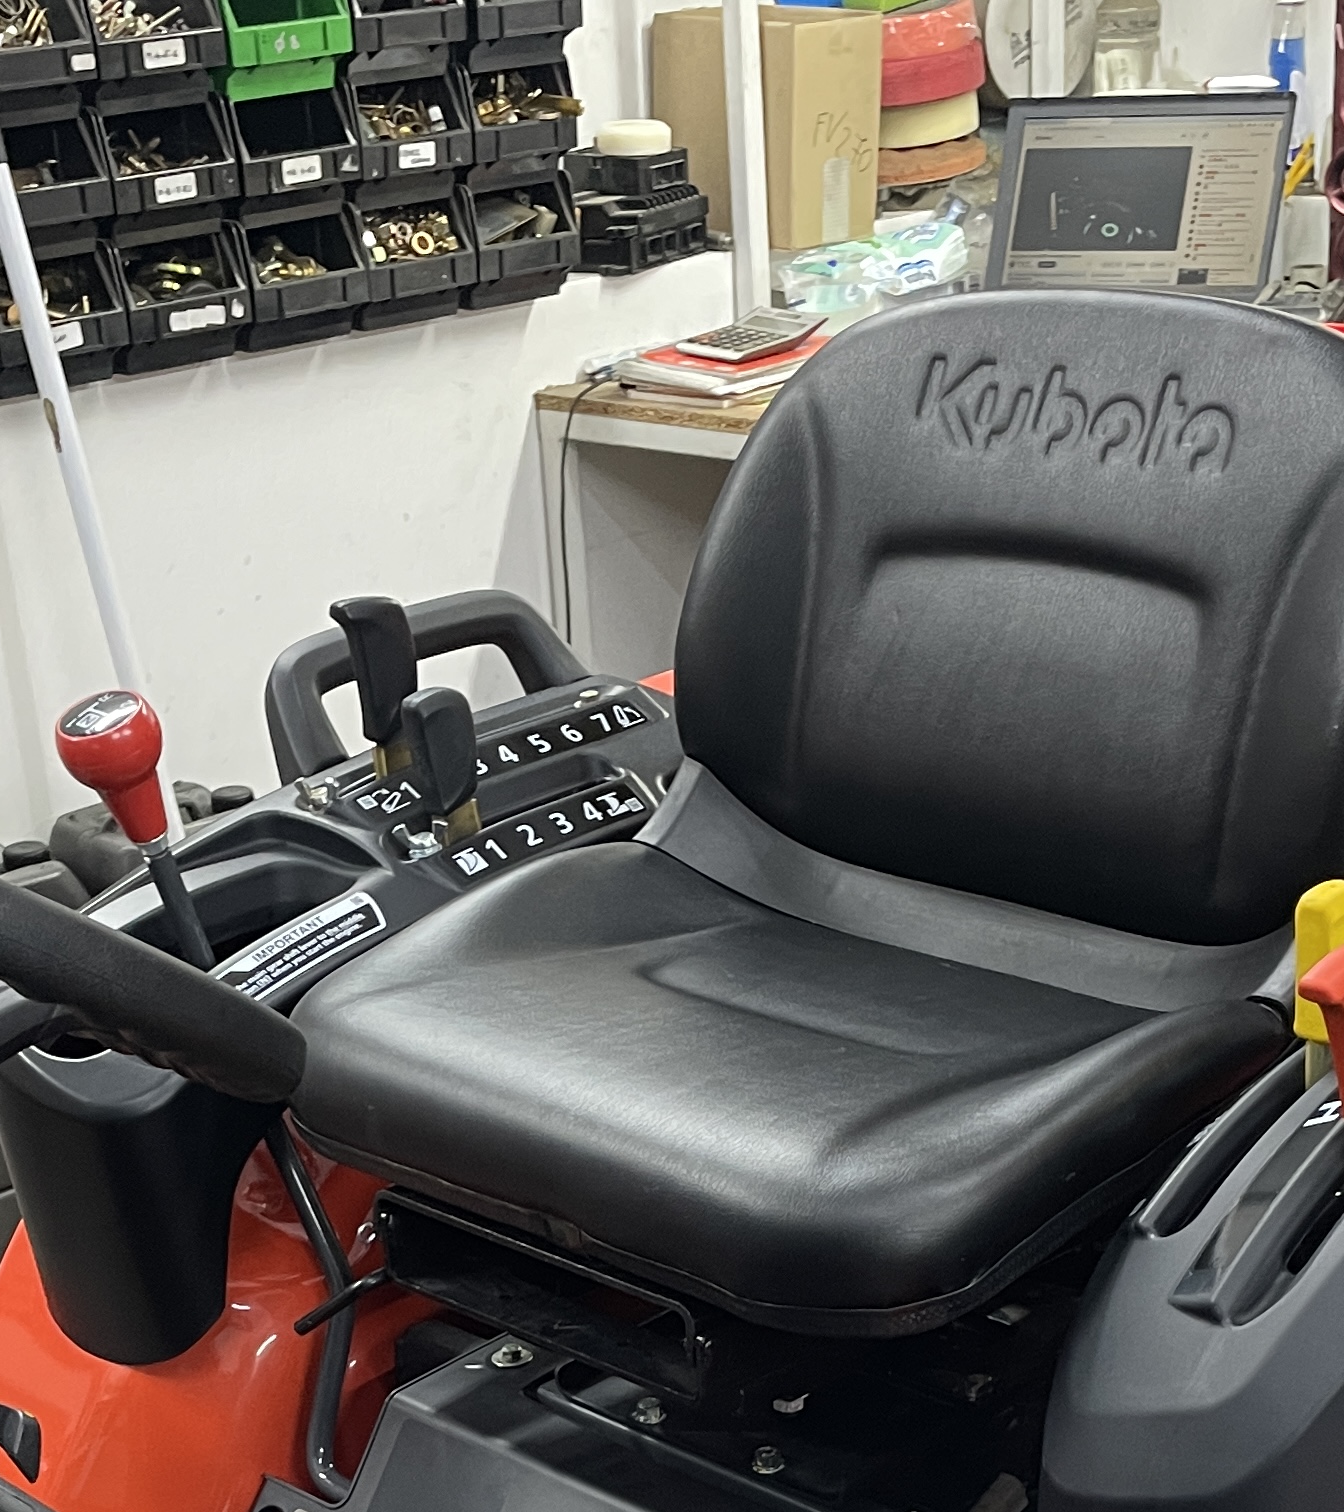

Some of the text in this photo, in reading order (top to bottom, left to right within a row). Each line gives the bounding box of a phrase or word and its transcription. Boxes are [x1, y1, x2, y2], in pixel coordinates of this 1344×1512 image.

[914, 352, 1237, 474] Kubota
[400, 781, 422, 800] 1
[497, 744, 520, 764] 4
[526, 732, 552, 754] 5
[560, 723, 584, 743] 6
[589, 712, 612, 733] 7
[484, 800, 604, 861] 1 2 3 4
[251, 914, 325, 963] IMPORTANT
